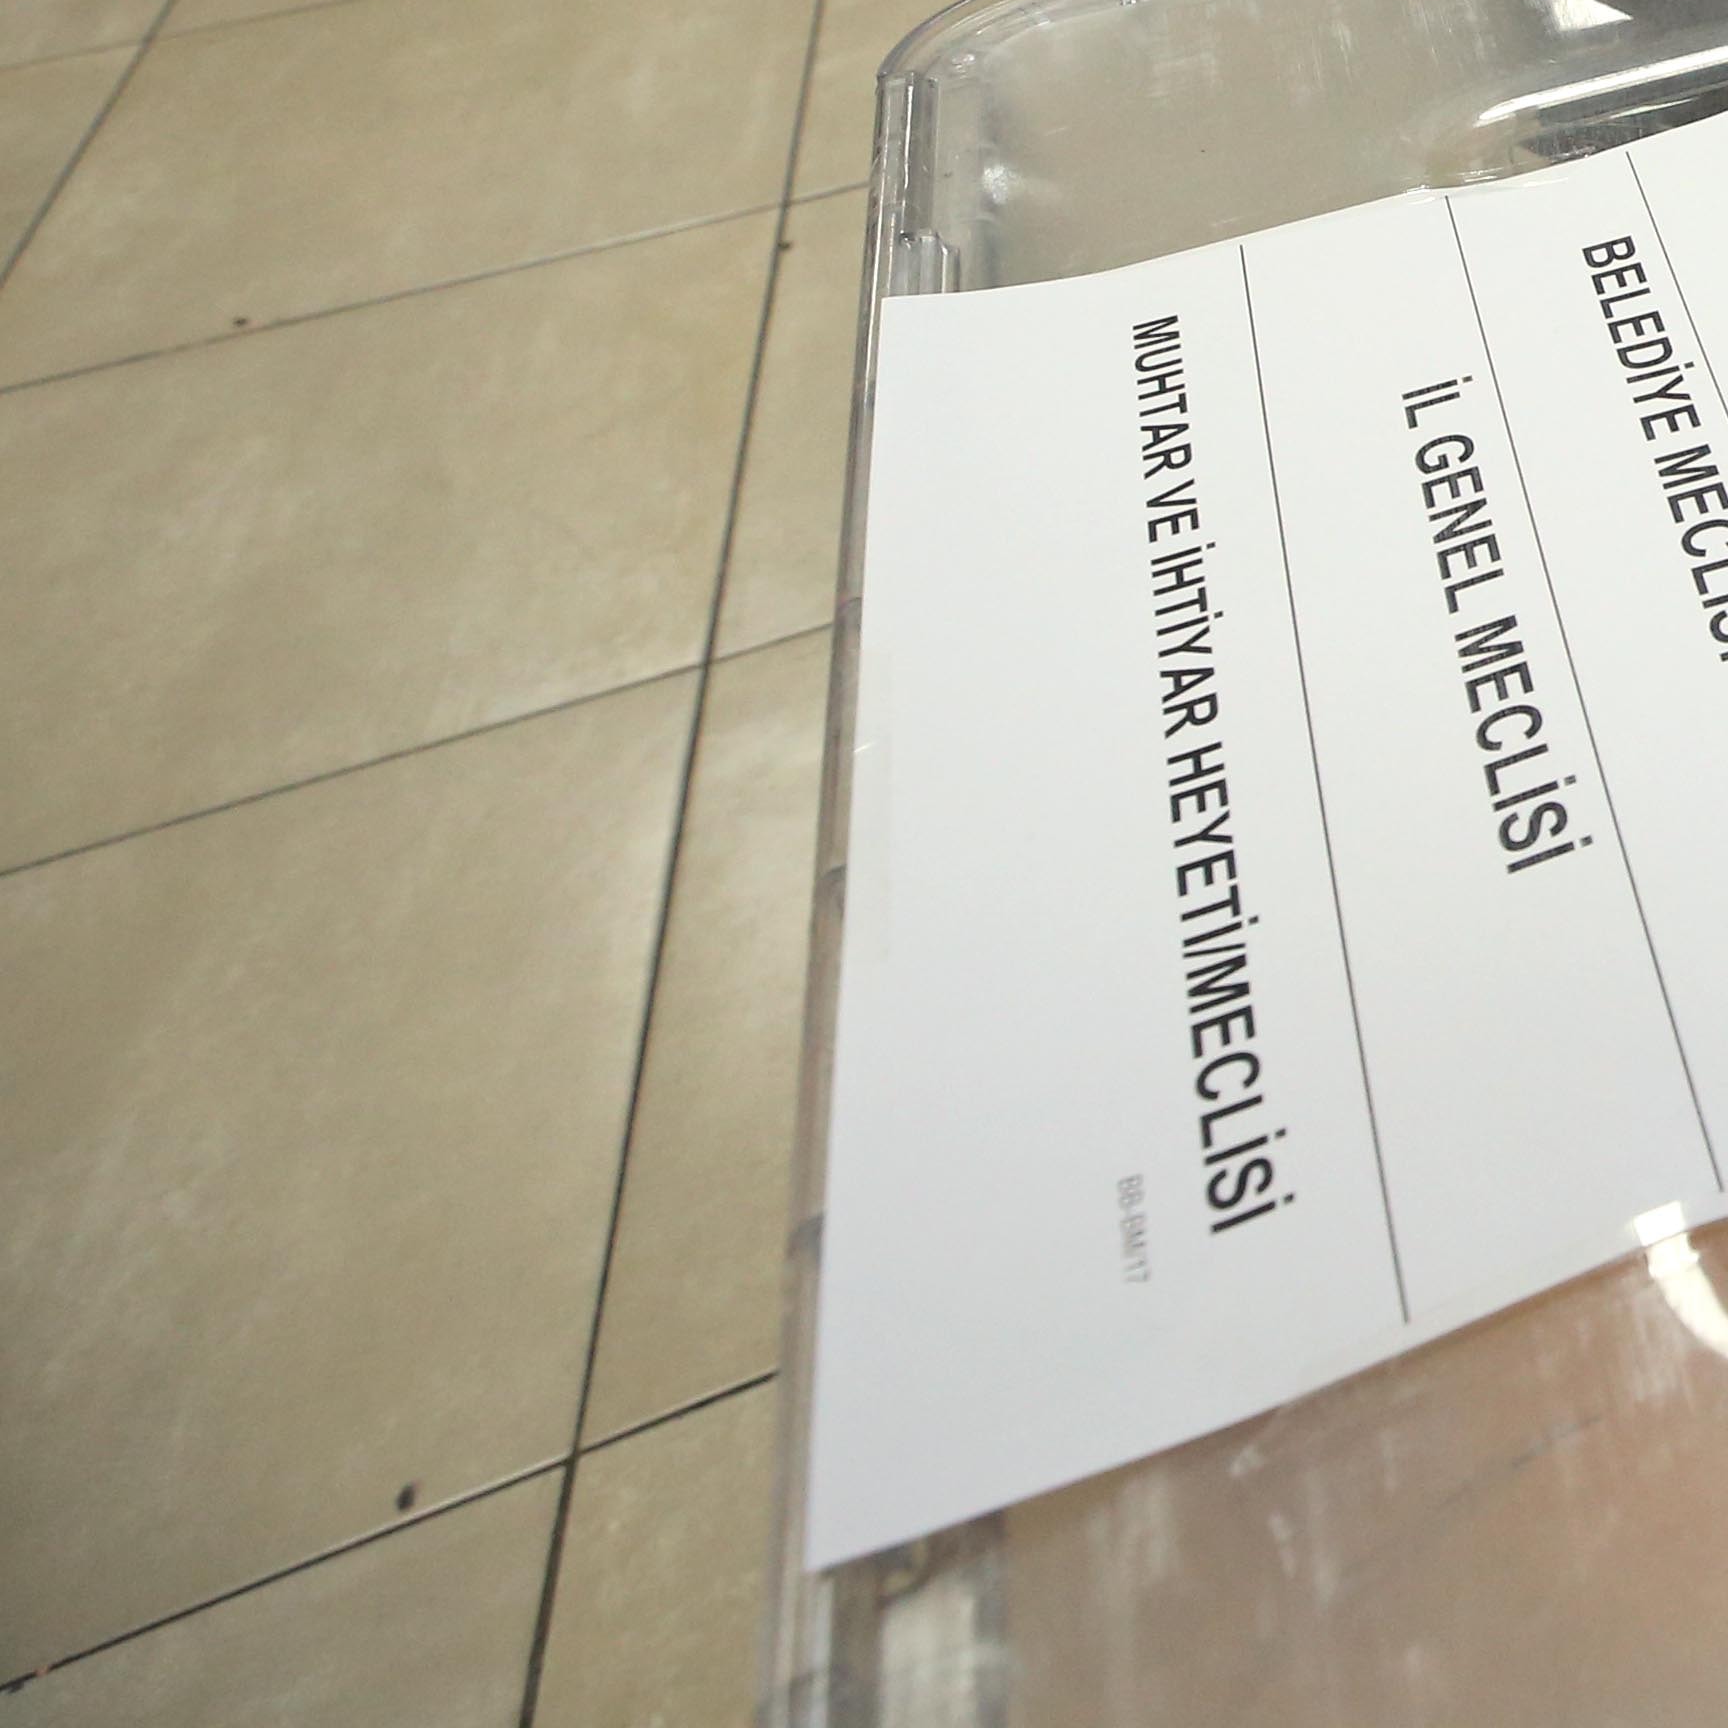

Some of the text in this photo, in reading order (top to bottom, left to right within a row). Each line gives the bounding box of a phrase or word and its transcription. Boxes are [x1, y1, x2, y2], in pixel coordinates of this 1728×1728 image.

[1581, 236, 1701, 442] BELEDİYE
[1132, 315, 1294, 1235] MUHTAR VE İHTİYAR HEYETİ/MECLİSİ
[1401, 375, 1593, 875] İL GENEL MECLİSİ
